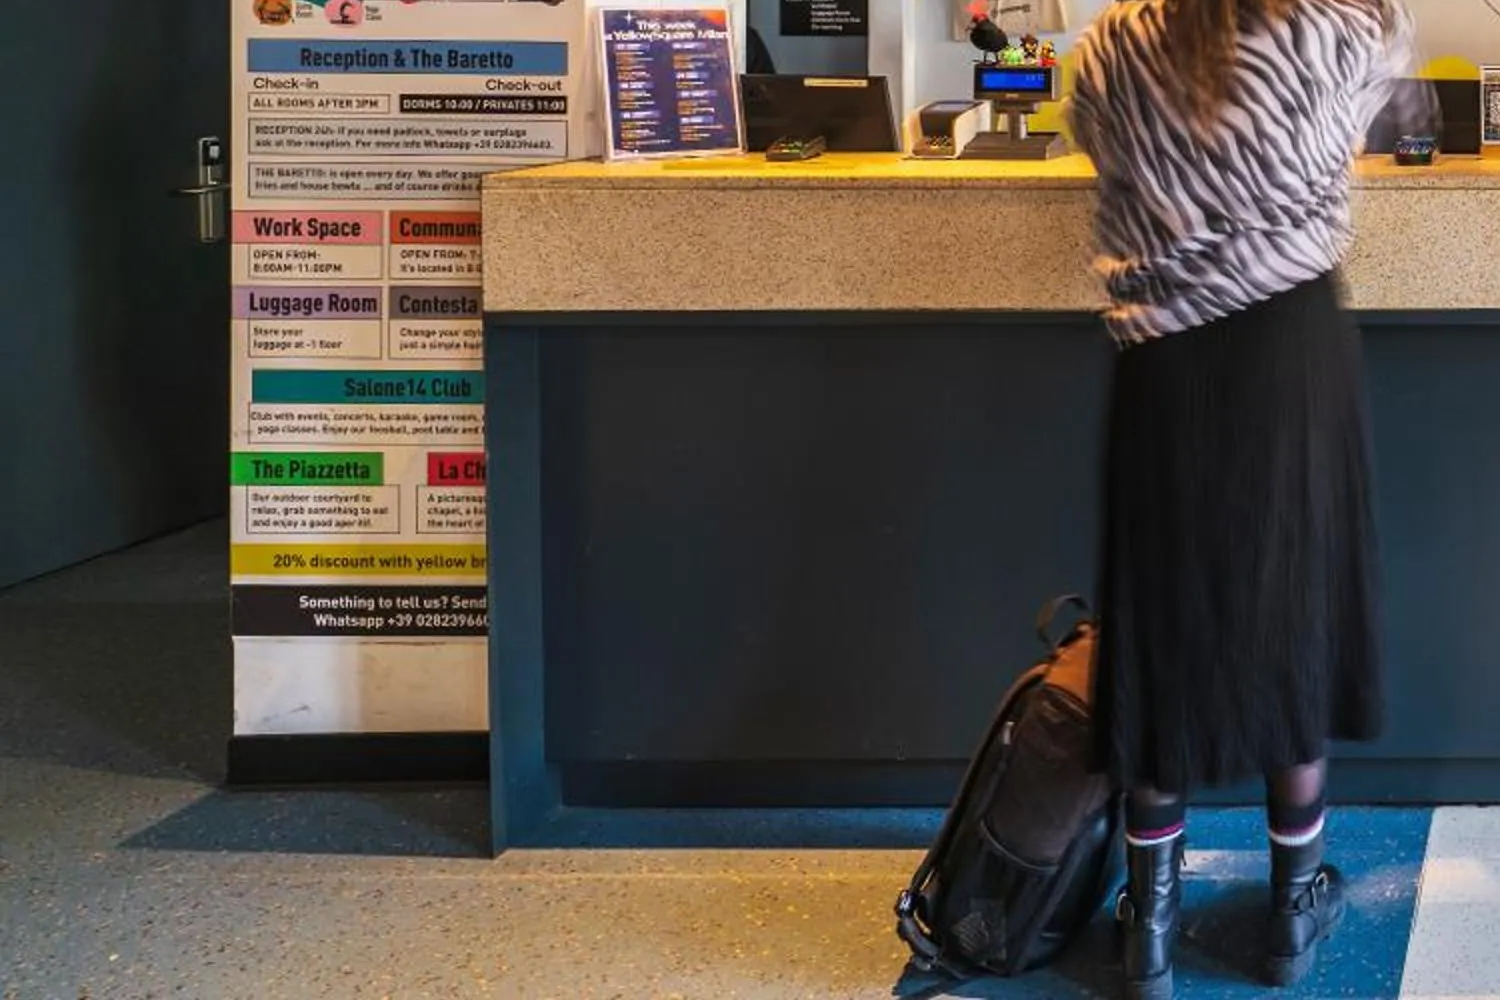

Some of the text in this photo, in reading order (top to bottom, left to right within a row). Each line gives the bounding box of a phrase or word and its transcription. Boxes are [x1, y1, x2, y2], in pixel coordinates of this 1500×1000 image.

[300, 48, 513, 71] Reception & The Baretto
[253, 77, 319, 90] Check-in
[485, 78, 562, 91] Check-out
[253, 98, 379, 109] ALL ROOMS AFTER 3PM
[402, 99, 442, 109] DORMS
[483, 100, 534, 110] PRIVATES
[255, 125, 312, 135] RECEPTION
[347, 127, 364, 137] you
[366, 126, 391, 135] need
[471, 129, 481, 137] or
[286, 138, 302, 148] the
[255, 167, 274, 177] THE
[339, 170, 363, 179] open
[280, 181, 298, 190] and
[374, 181, 393, 190] and
[254, 217, 361, 240] Work Space
[400, 217, 481, 237] Commun
[253, 249, 283, 259] OPEN
[400, 249, 430, 259] OPEN
[417, 263, 453, 273] located
[249, 292, 378, 316] Luggage Room
[400, 294, 478, 314] Contesta
[253, 339, 292, 350] luggage
[344, 377, 471, 397] Salone14 Club
[251, 411, 272, 420] Club
[274, 411, 294, 420] with
[252, 459, 370, 479] The Piazzetta
[439, 461, 458, 480] La
[273, 555, 306, 568] 20%
[309, 554, 375, 568] discount
[379, 554, 412, 568] with
[416, 555, 466, 571] yellow
[299, 595, 488, 611] Something to tell us? Send
[313, 613, 384, 629] Whatsapp
[387, 614, 412, 627] +39
